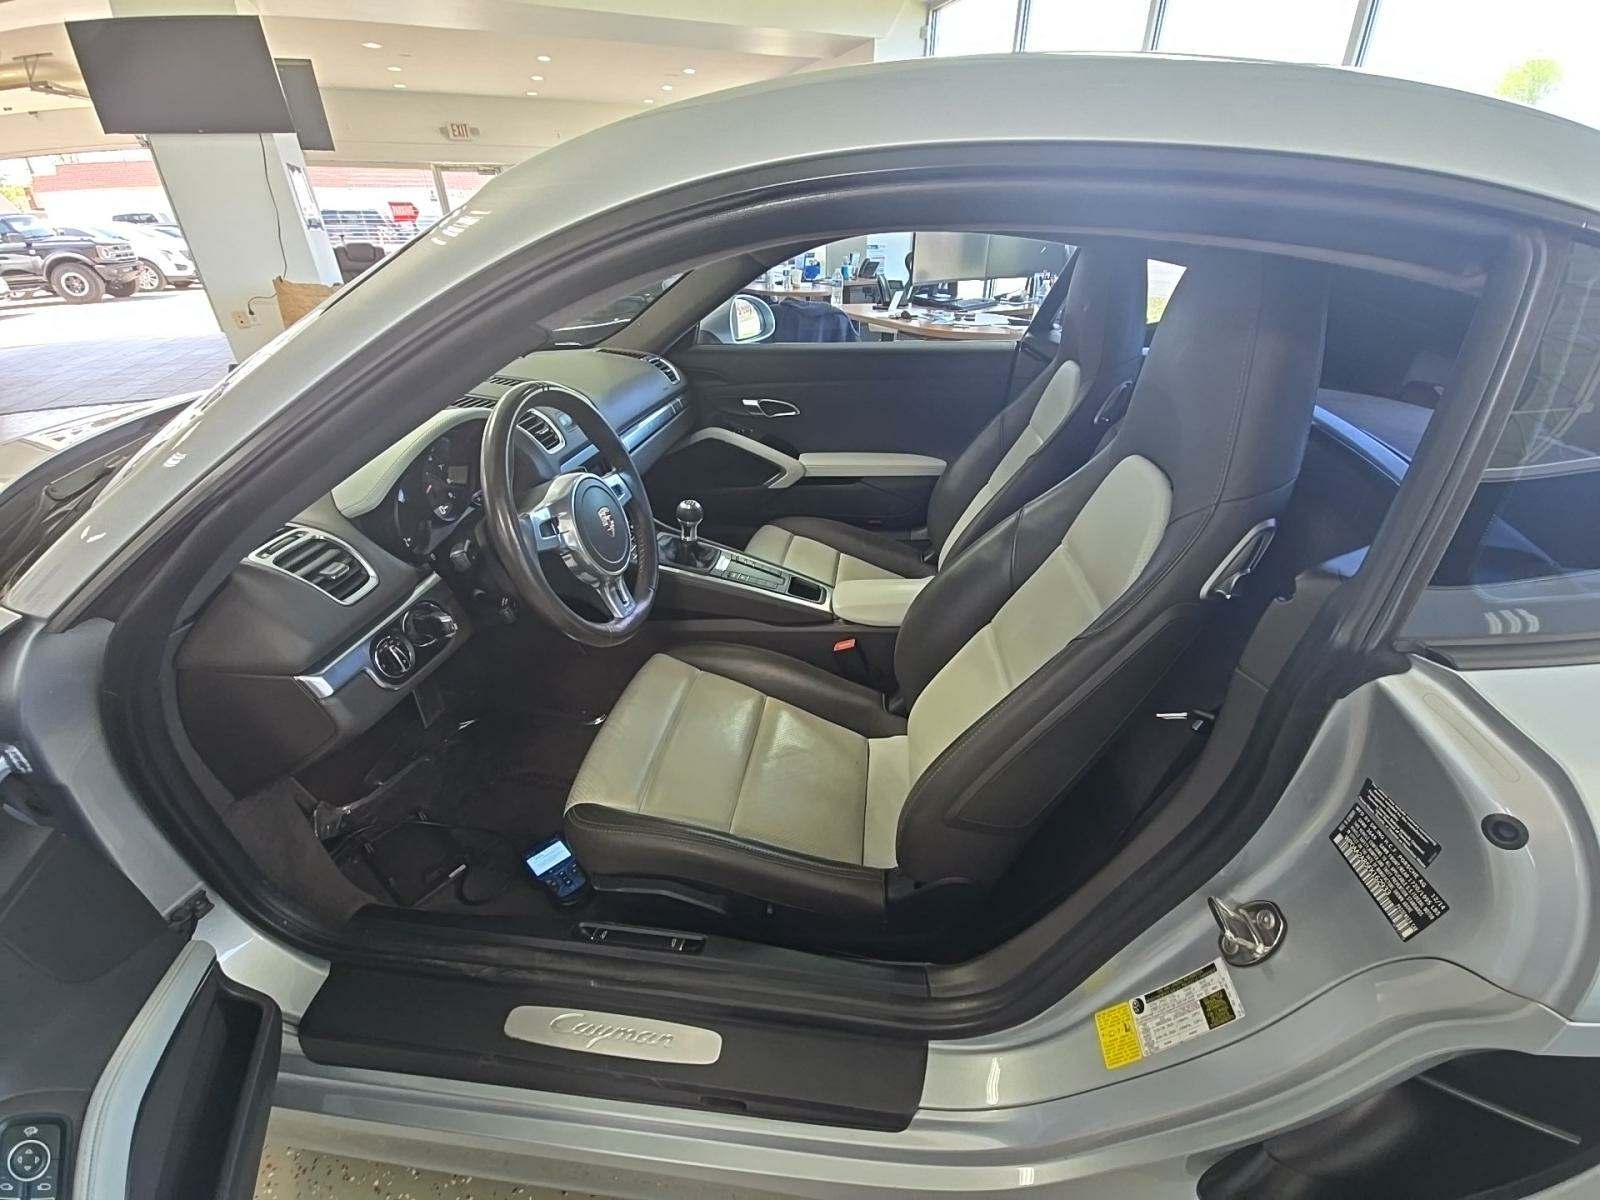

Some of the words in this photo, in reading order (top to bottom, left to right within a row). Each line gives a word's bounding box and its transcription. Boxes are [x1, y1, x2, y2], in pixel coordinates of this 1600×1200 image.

[450, 123, 469, 138] EXIT
[1363, 815, 1370, 824] BY
[1396, 853, 1419, 879] PORSCHE
[1417, 878, 1427, 888] AG
[1430, 892, 1446, 910] 12/14
[548, 1012, 675, 1050] Cayman
